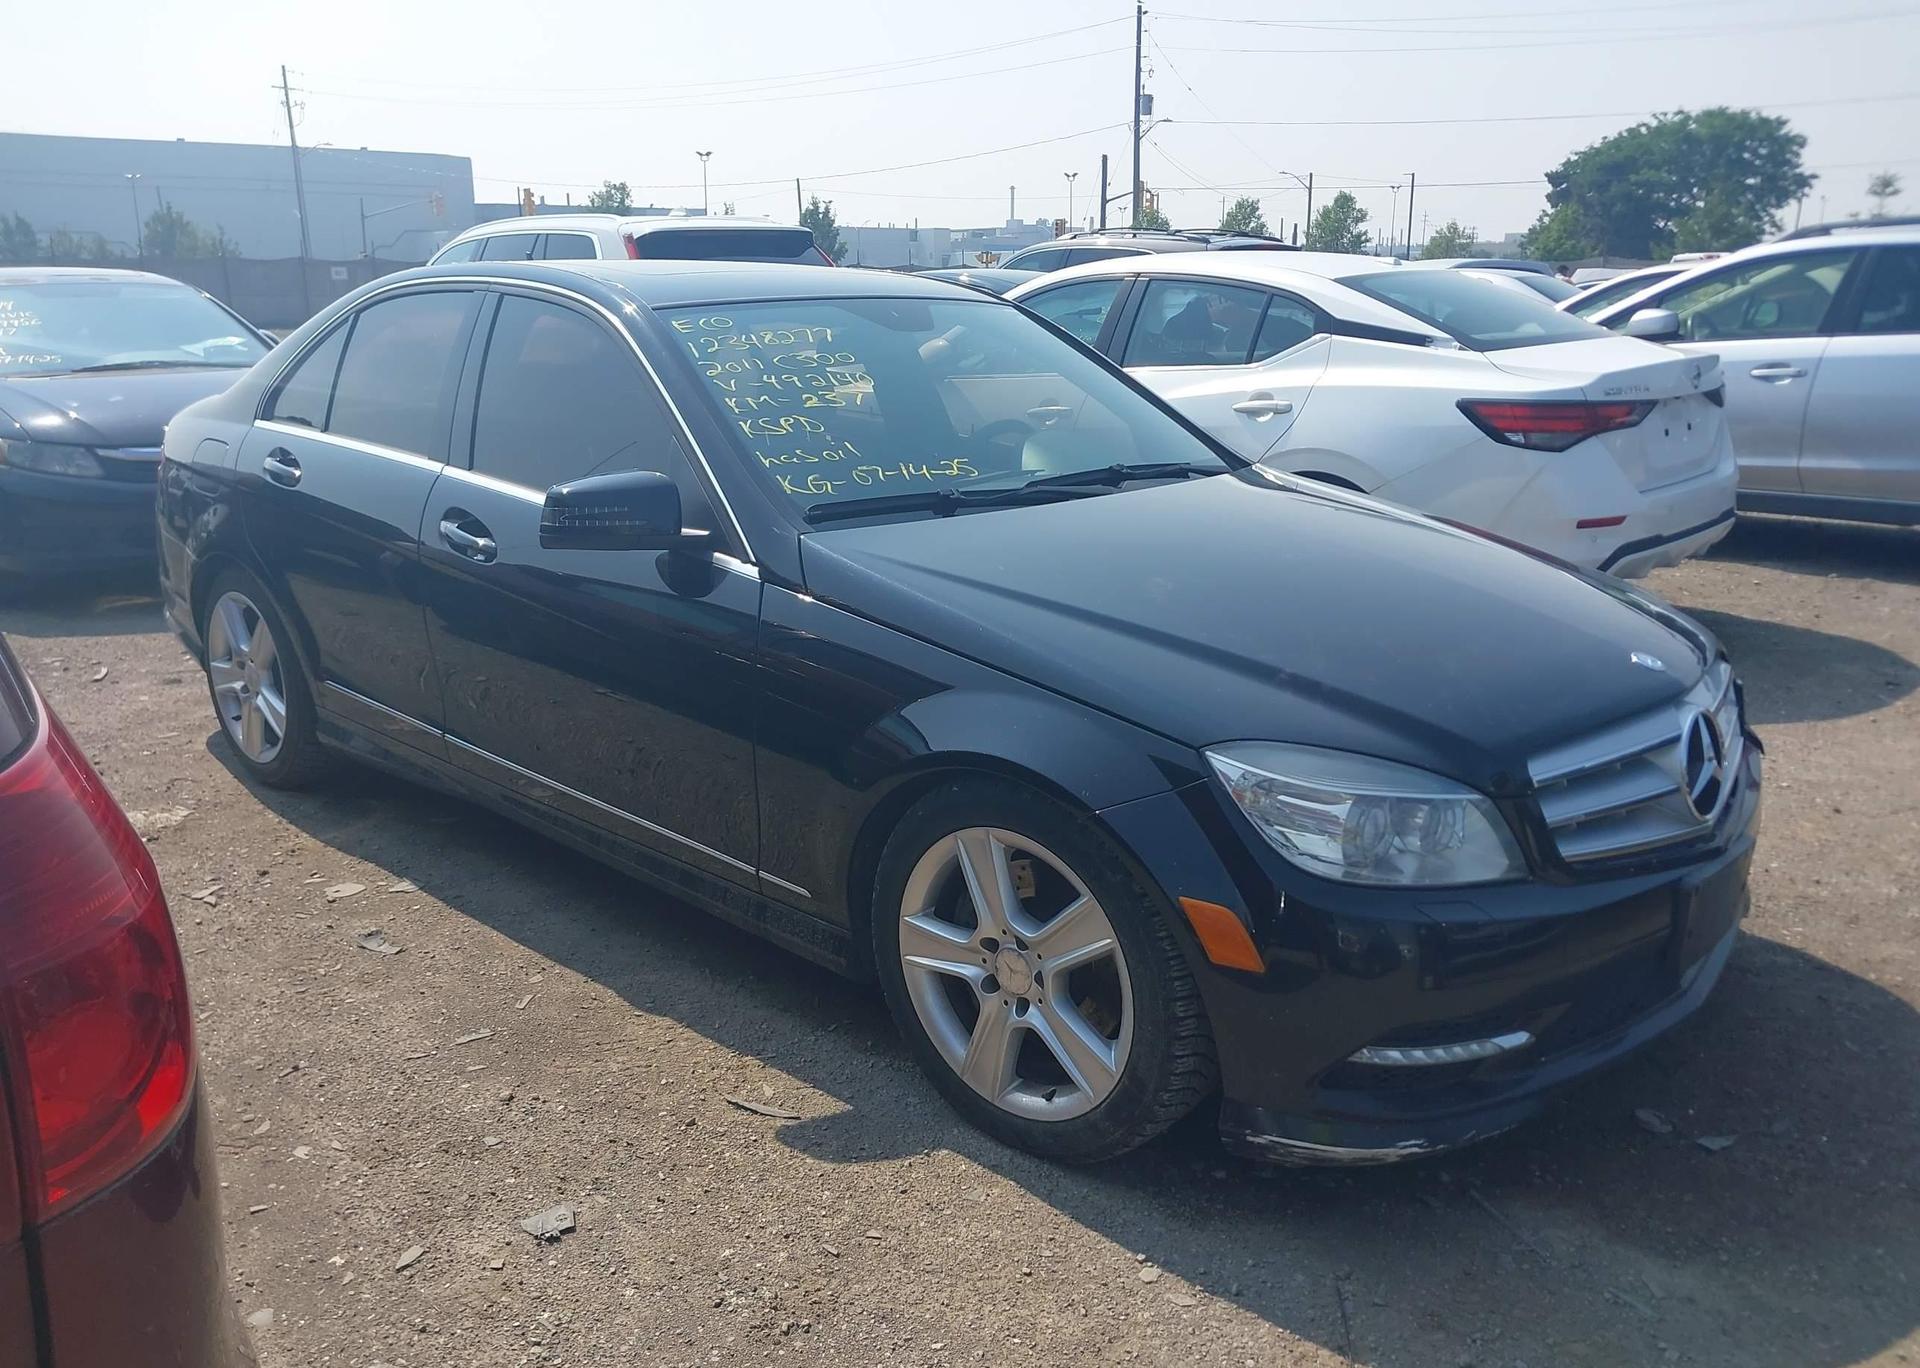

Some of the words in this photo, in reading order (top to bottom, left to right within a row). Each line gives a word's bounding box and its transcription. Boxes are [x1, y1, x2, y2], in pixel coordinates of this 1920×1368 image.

[671, 316, 733, 334] ECO
[687, 327, 833, 359] 12348277
[697, 357, 765, 377] 2011
[772, 352, 856, 370] C300
[738, 413, 825, 439] KSPD
